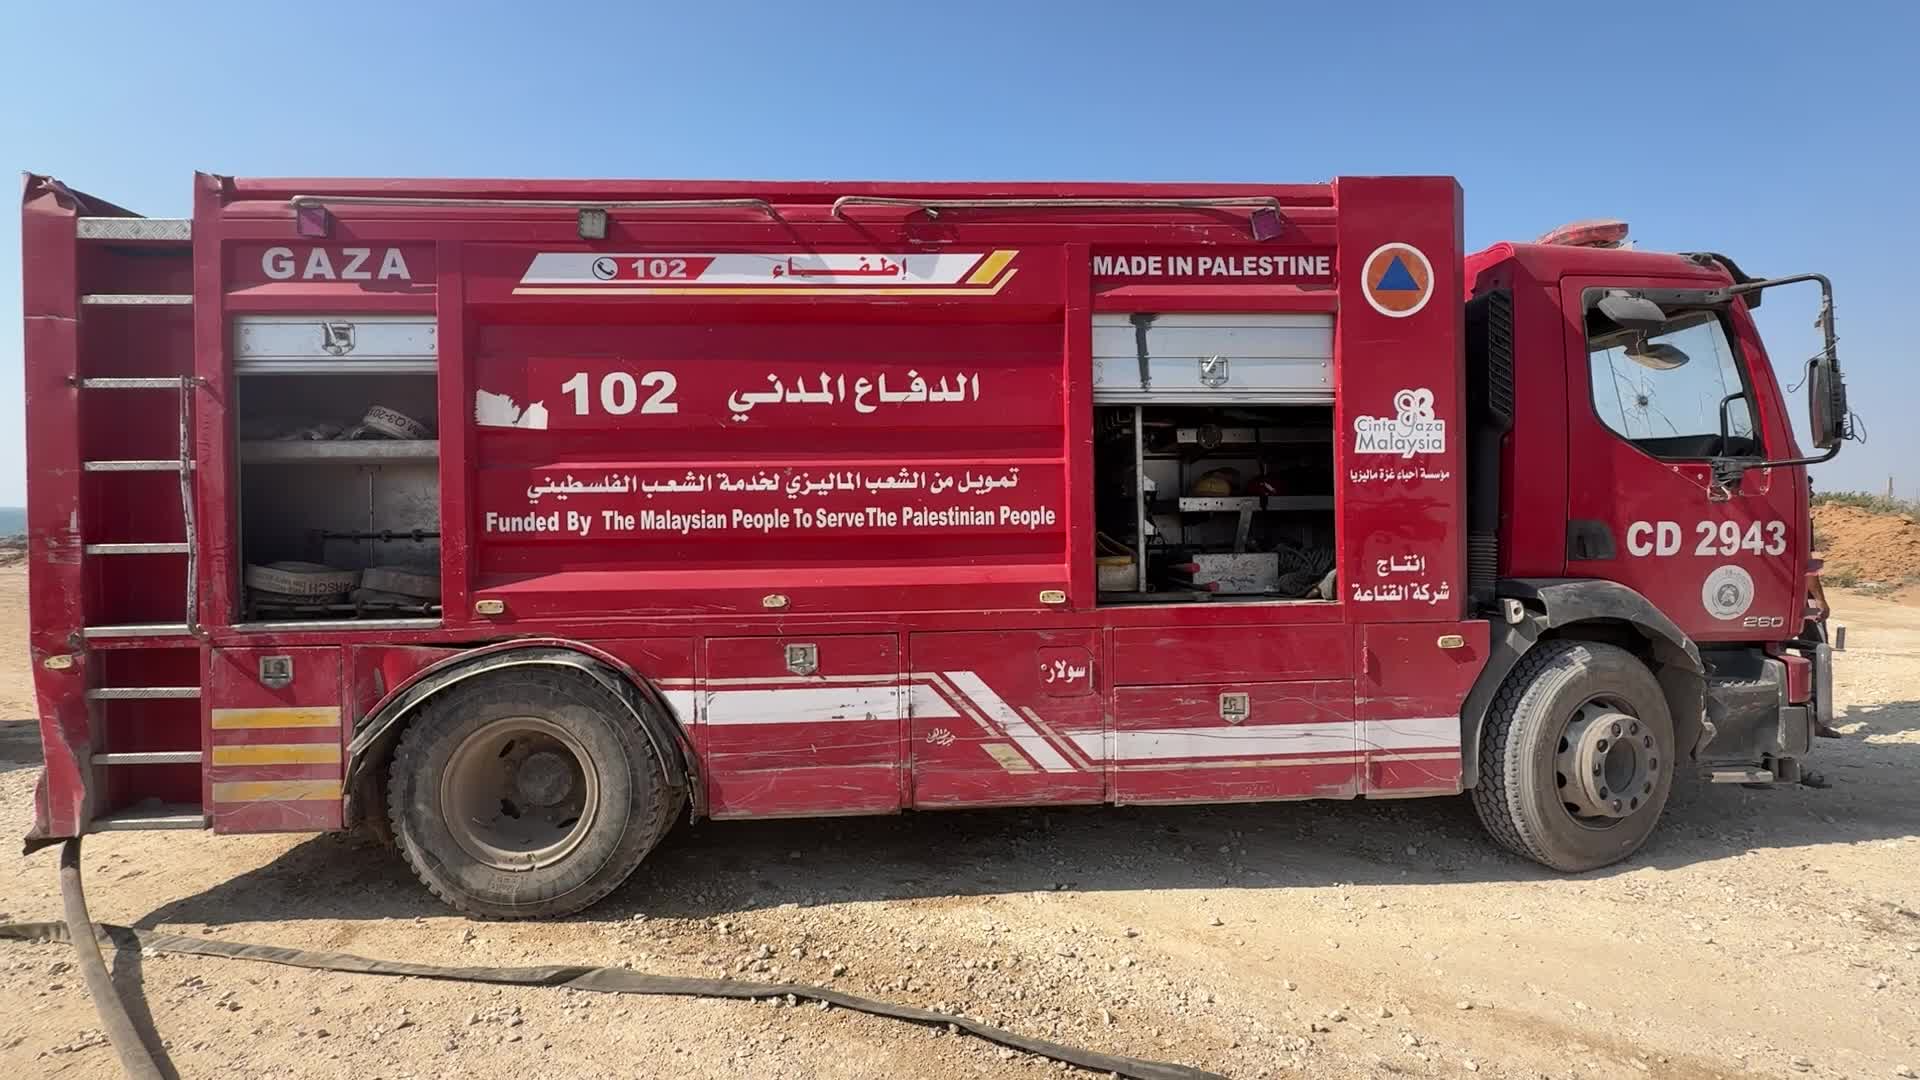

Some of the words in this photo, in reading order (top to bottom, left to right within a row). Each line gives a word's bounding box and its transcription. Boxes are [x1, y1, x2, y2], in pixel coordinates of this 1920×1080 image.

[262, 247, 411, 280] GAZA
[631, 259, 687, 278] 102
[1093, 256, 1162, 275] MADE
[1168, 257, 1192, 275] IN
[1198, 256, 1330, 275] PALESTINE
[561, 371, 679, 415] 102
[728, 371, 846, 422] المدني
[854, 368, 981, 413] الدفاع
[1358, 419, 1396, 432] Cinta
[1359, 433, 1442, 455] Malaysia
[641, 470, 712, 498] الشعب
[716, 471, 780, 492] لخدمة
[785, 472, 861, 499] الماليزي
[865, 468, 926, 494] الشعب
[930, 472, 954, 494] من
[957, 467, 1020, 495] تمويل
[1350, 468, 1378, 483] ماليزيا
[1380, 468, 1395, 482] غزة
[1420, 467, 1450, 482] مؤسسة
[526, 472, 638, 504] الفلسطيني
[486, 511, 560, 533] Funded
[567, 511, 592, 536] By
[602, 510, 636, 531] The
[640, 509, 728, 534] Malaysian
[732, 507, 790, 534] People
[793, 508, 813, 528] To
[816, 507, 865, 528] Serve
[866, 507, 898, 528] The
[902, 505, 996, 527] Palestinian
[1000, 504, 1057, 530] People
[1627, 520, 1682, 557] CD
[1694, 520, 1787, 557] 2943
[1376, 553, 1426, 577] إنتاج
[1351, 582, 1409, 602] القناعة
[1410, 580, 1450, 606] شركة
[1743, 616, 1784, 628] 260
[1045, 659, 1086, 684] سولار
